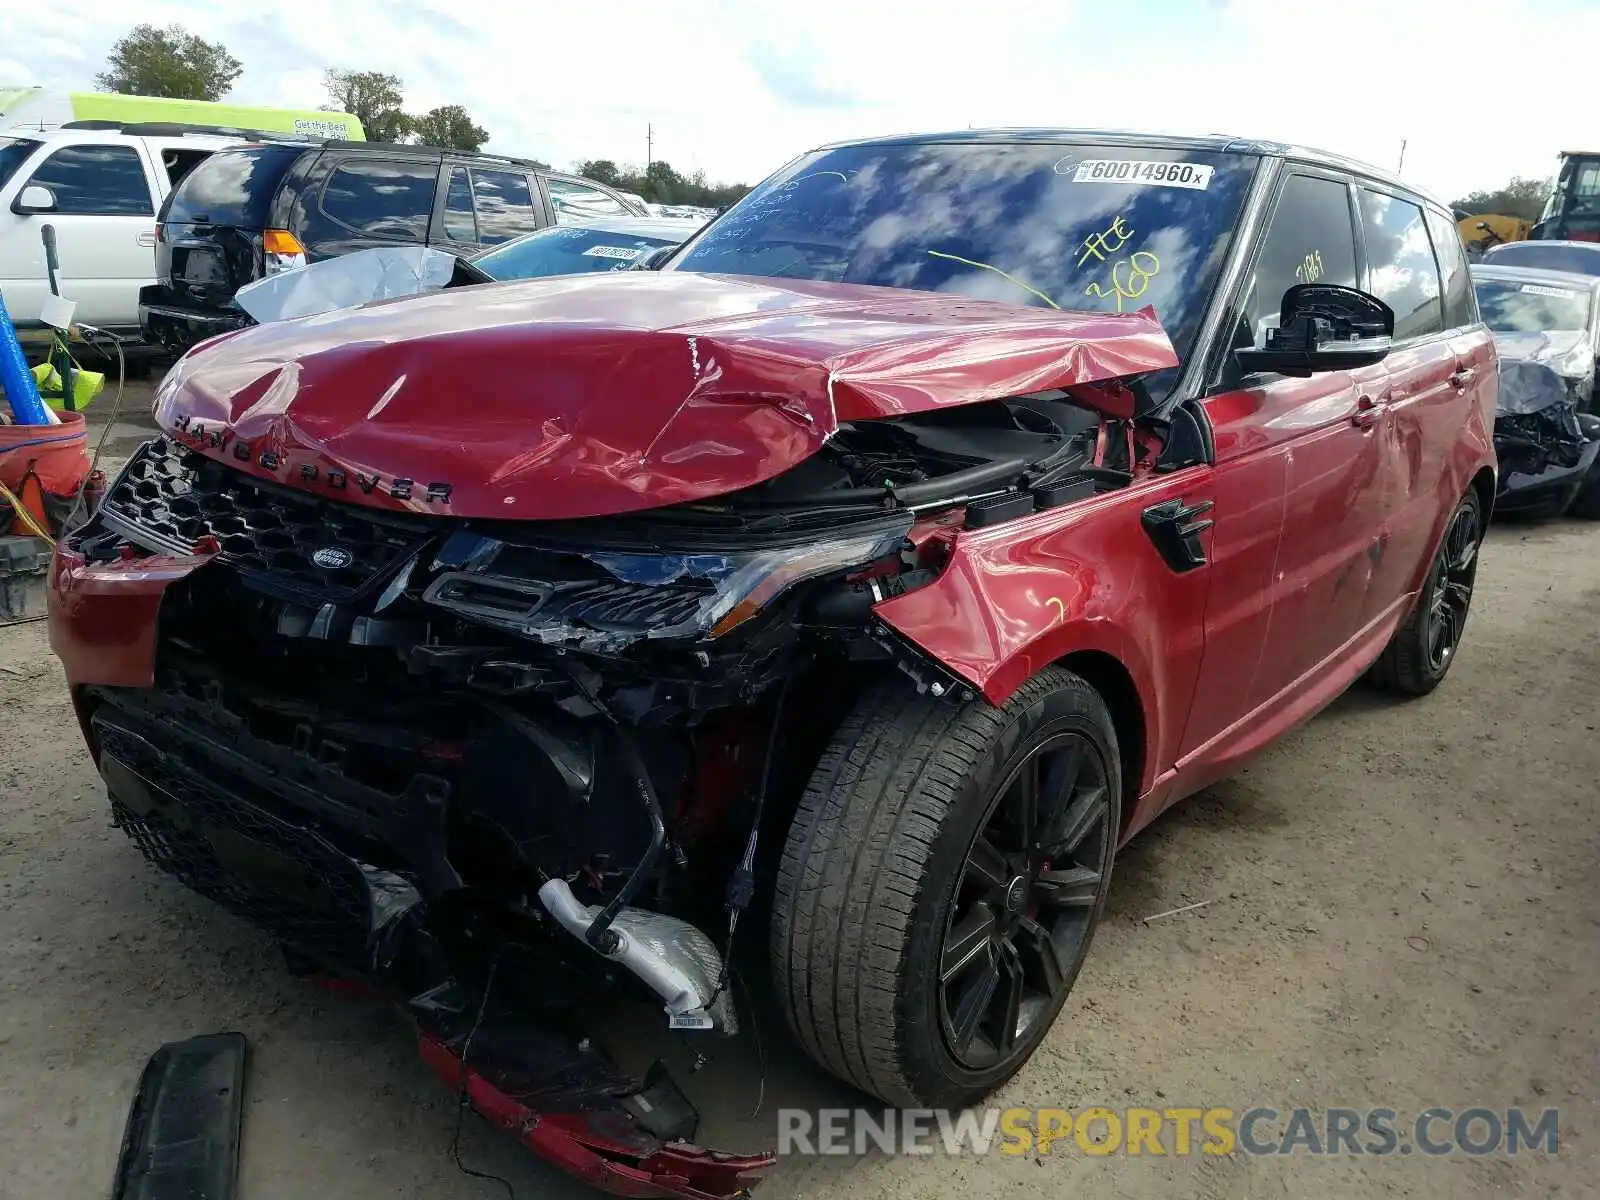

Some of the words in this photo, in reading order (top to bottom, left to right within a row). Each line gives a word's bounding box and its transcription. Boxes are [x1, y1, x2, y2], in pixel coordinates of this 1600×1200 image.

[295, 119, 311, 128] Get
[312, 120, 326, 129] the
[328, 121, 346, 131] Best
[301, 463, 453, 504] ROVER
[318, 555, 344, 566] ROVER
